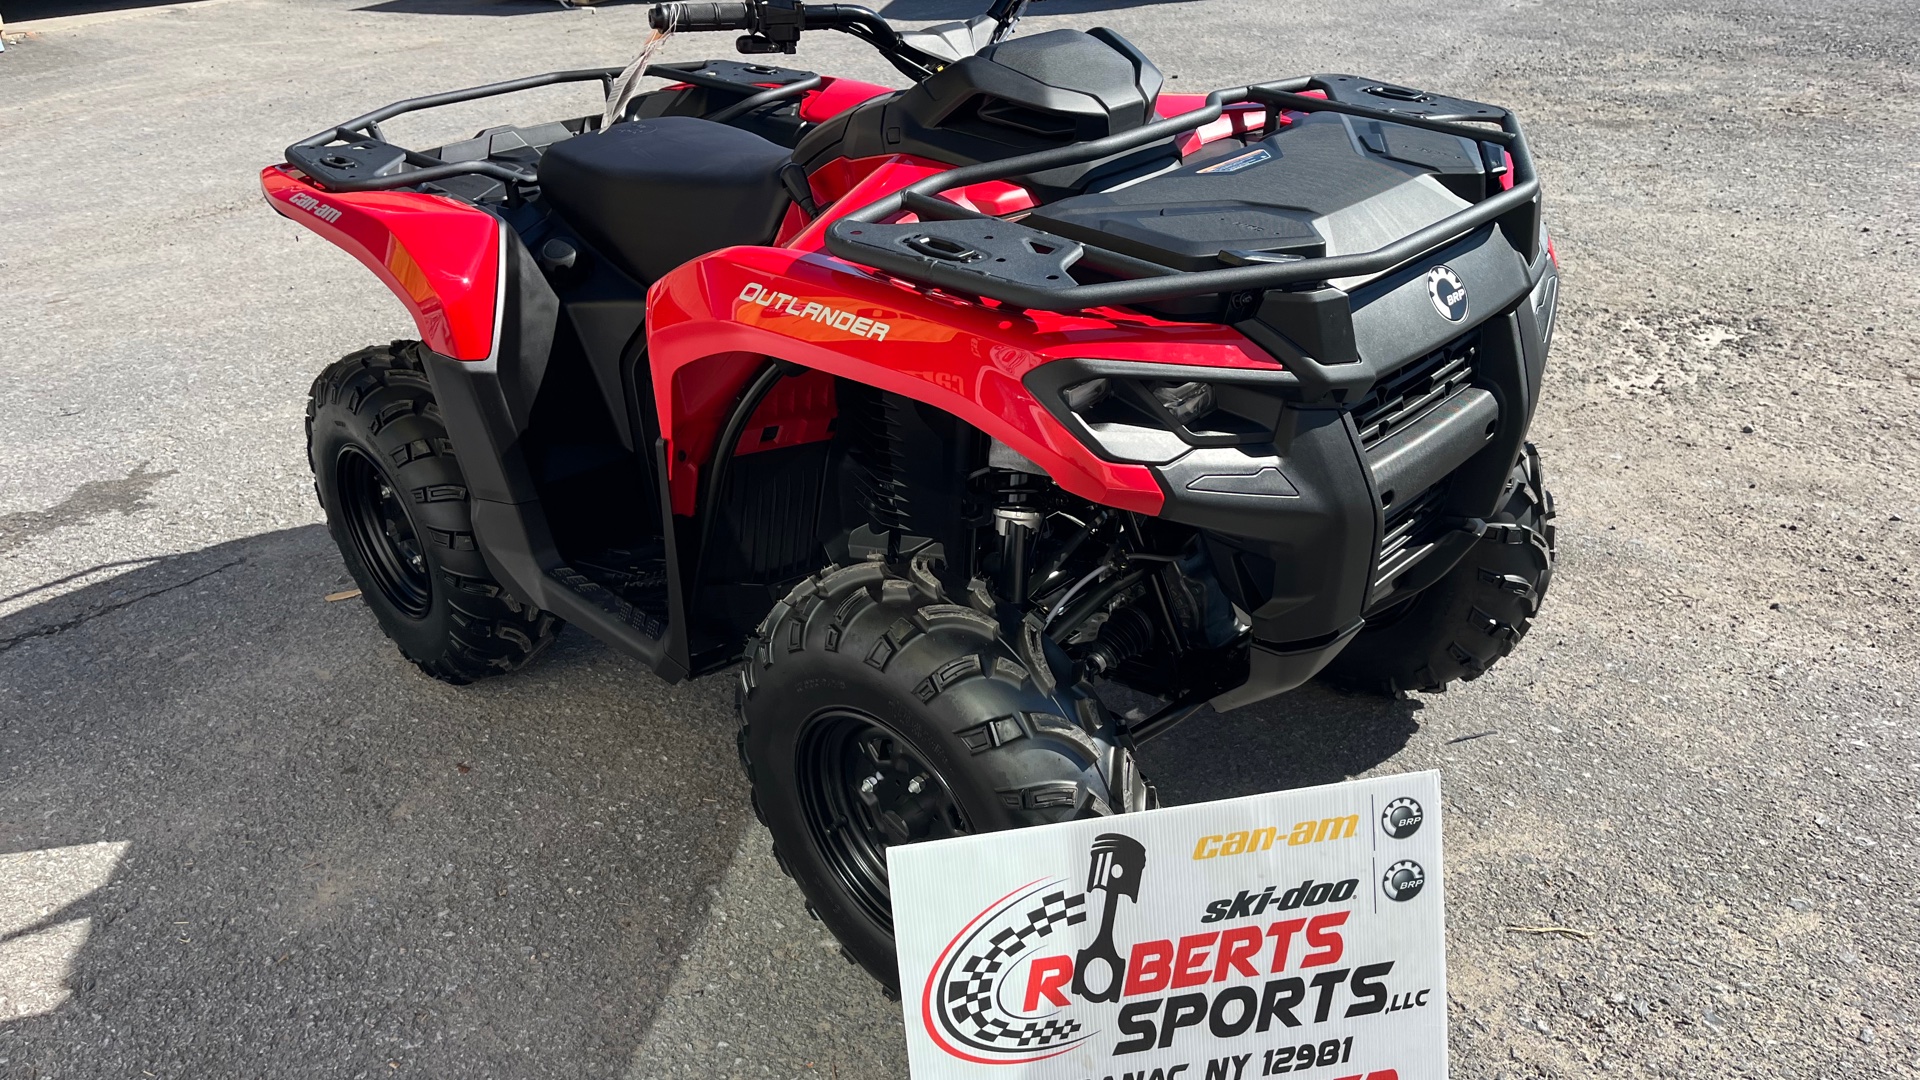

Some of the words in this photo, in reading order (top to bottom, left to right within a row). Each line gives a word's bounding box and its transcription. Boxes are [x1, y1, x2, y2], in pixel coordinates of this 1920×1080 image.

[289, 192, 342, 223] can-am
[739, 282, 890, 342] OUTLANDER
[1446, 288, 1465, 306] BRP
[1192, 814, 1359, 860] can-am
[1398, 816, 1422, 827] BRP
[1400, 879, 1423, 891] BRP
[1204, 1052, 1253, 1080] NY
[1262, 1036, 1354, 1077] 12981
